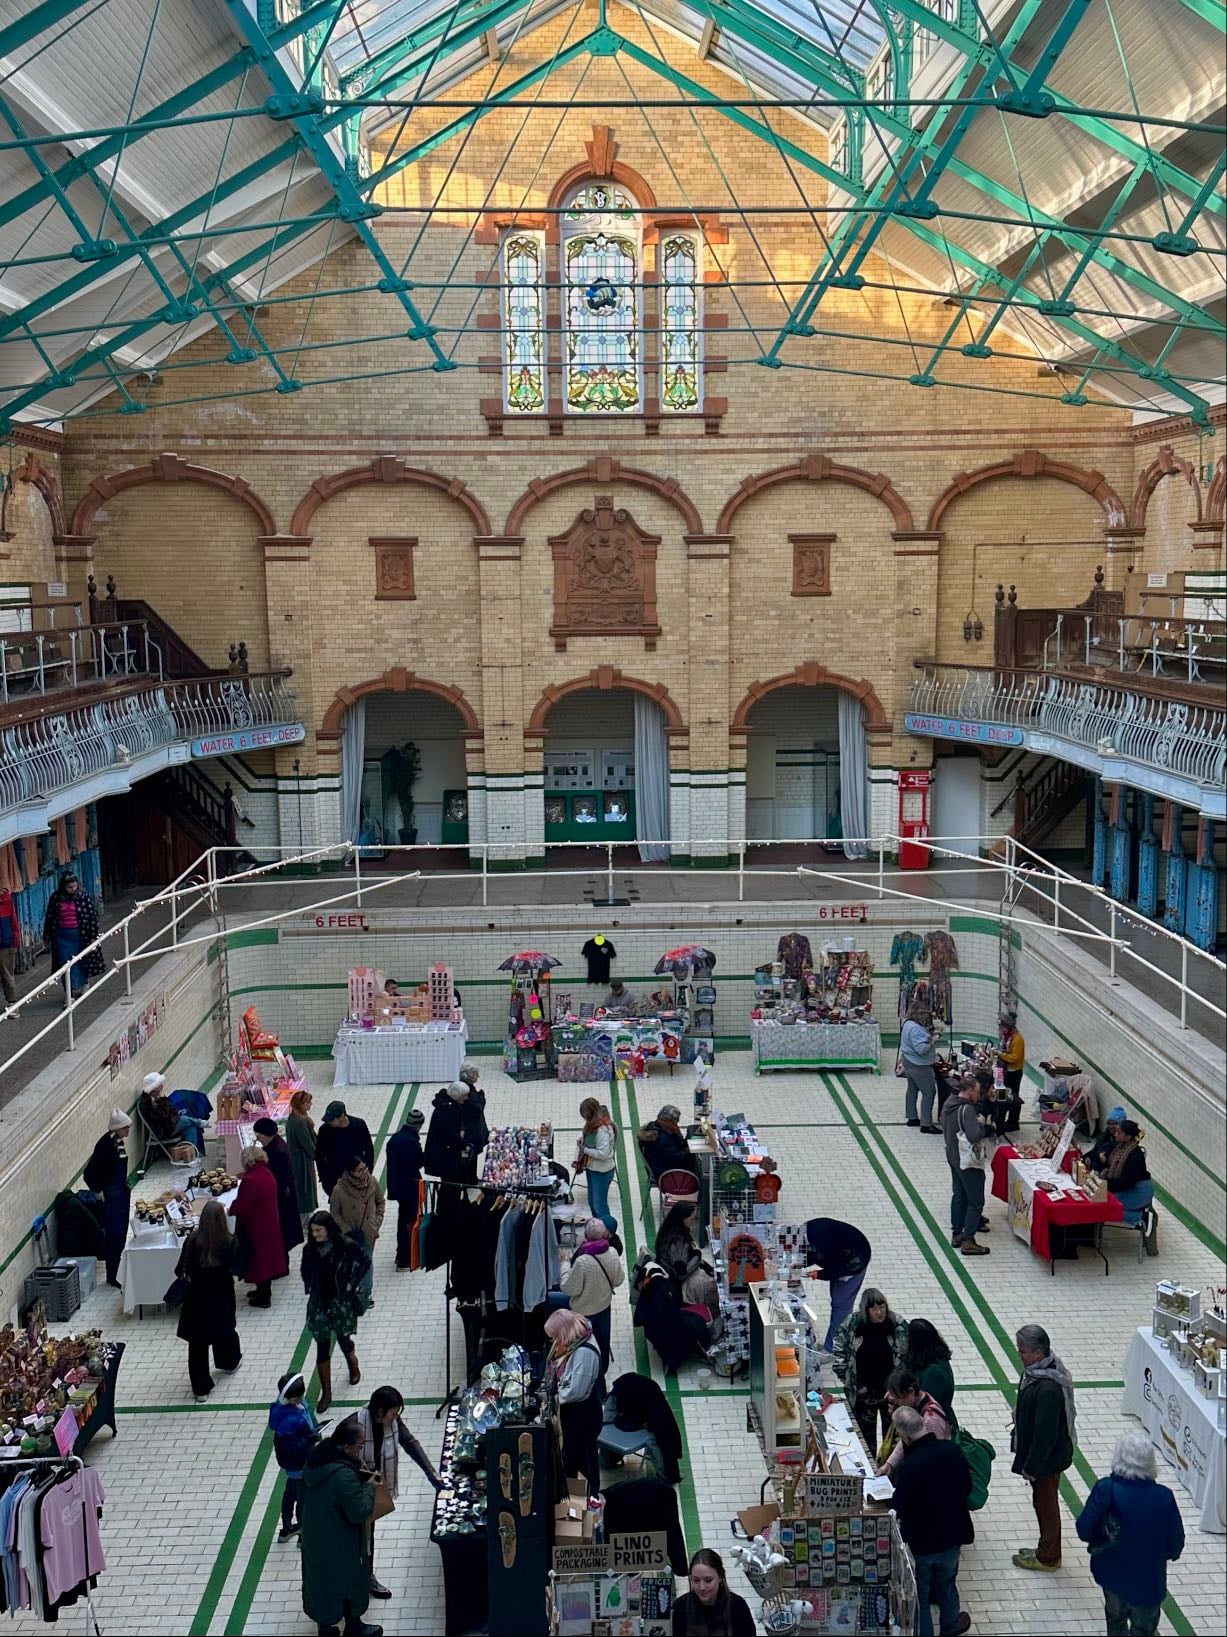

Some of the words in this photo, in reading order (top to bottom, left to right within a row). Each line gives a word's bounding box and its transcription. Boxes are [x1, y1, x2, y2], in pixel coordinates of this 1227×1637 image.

[912, 718, 943, 731] WATER
[948, 722, 955, 734] 6
[959, 725, 981, 737] FEET
[200, 737, 234, 753] WATER
[240, 735, 247, 747] 6
[251, 731, 272, 744] FEET
[278, 728, 300, 741] DEEP
[820, 907, 827, 919] 6
[832, 906, 868, 918] FEET
[315, 915, 324, 928] 6
[329, 915, 366, 928] FEET
[810, 1477, 858, 1487] MINIATURE
[810, 1486, 829, 1496] BUG
[831, 1487, 858, 1496] PRINTS
[614, 1535, 651, 1550] LINO
[554, 1547, 609, 1559] COMPOSTABLE
[614, 1549, 664, 1566] PRINTS
[556, 1557, 608, 1569] PACKAGING
[643, 1578, 671, 1586] PRICES
